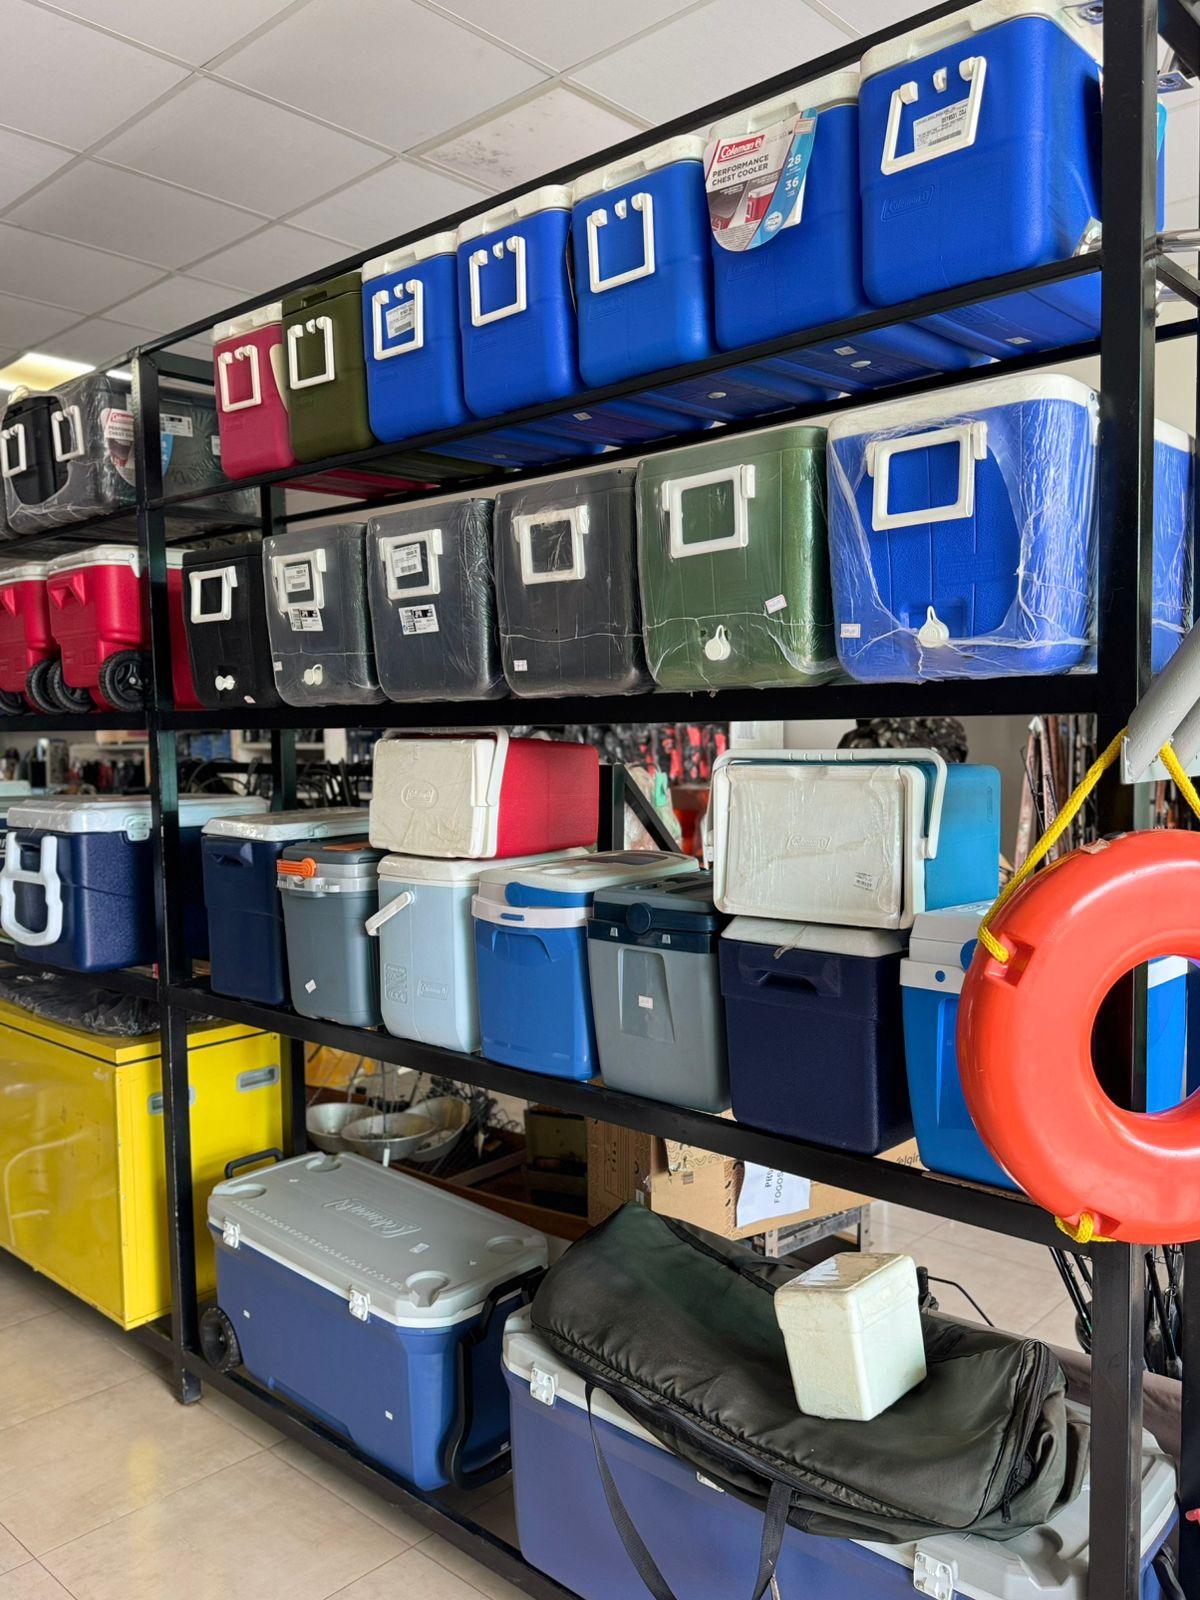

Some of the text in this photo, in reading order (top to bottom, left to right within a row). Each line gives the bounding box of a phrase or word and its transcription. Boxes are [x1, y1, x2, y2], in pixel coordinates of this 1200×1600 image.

[721, 142, 755, 158] Coleman
[712, 154, 769, 177] PERFORMANCE
[787, 154, 801, 168] 28
[712, 173, 736, 186] CHEST
[737, 163, 769, 178] COOLER
[785, 176, 800, 191] 36
